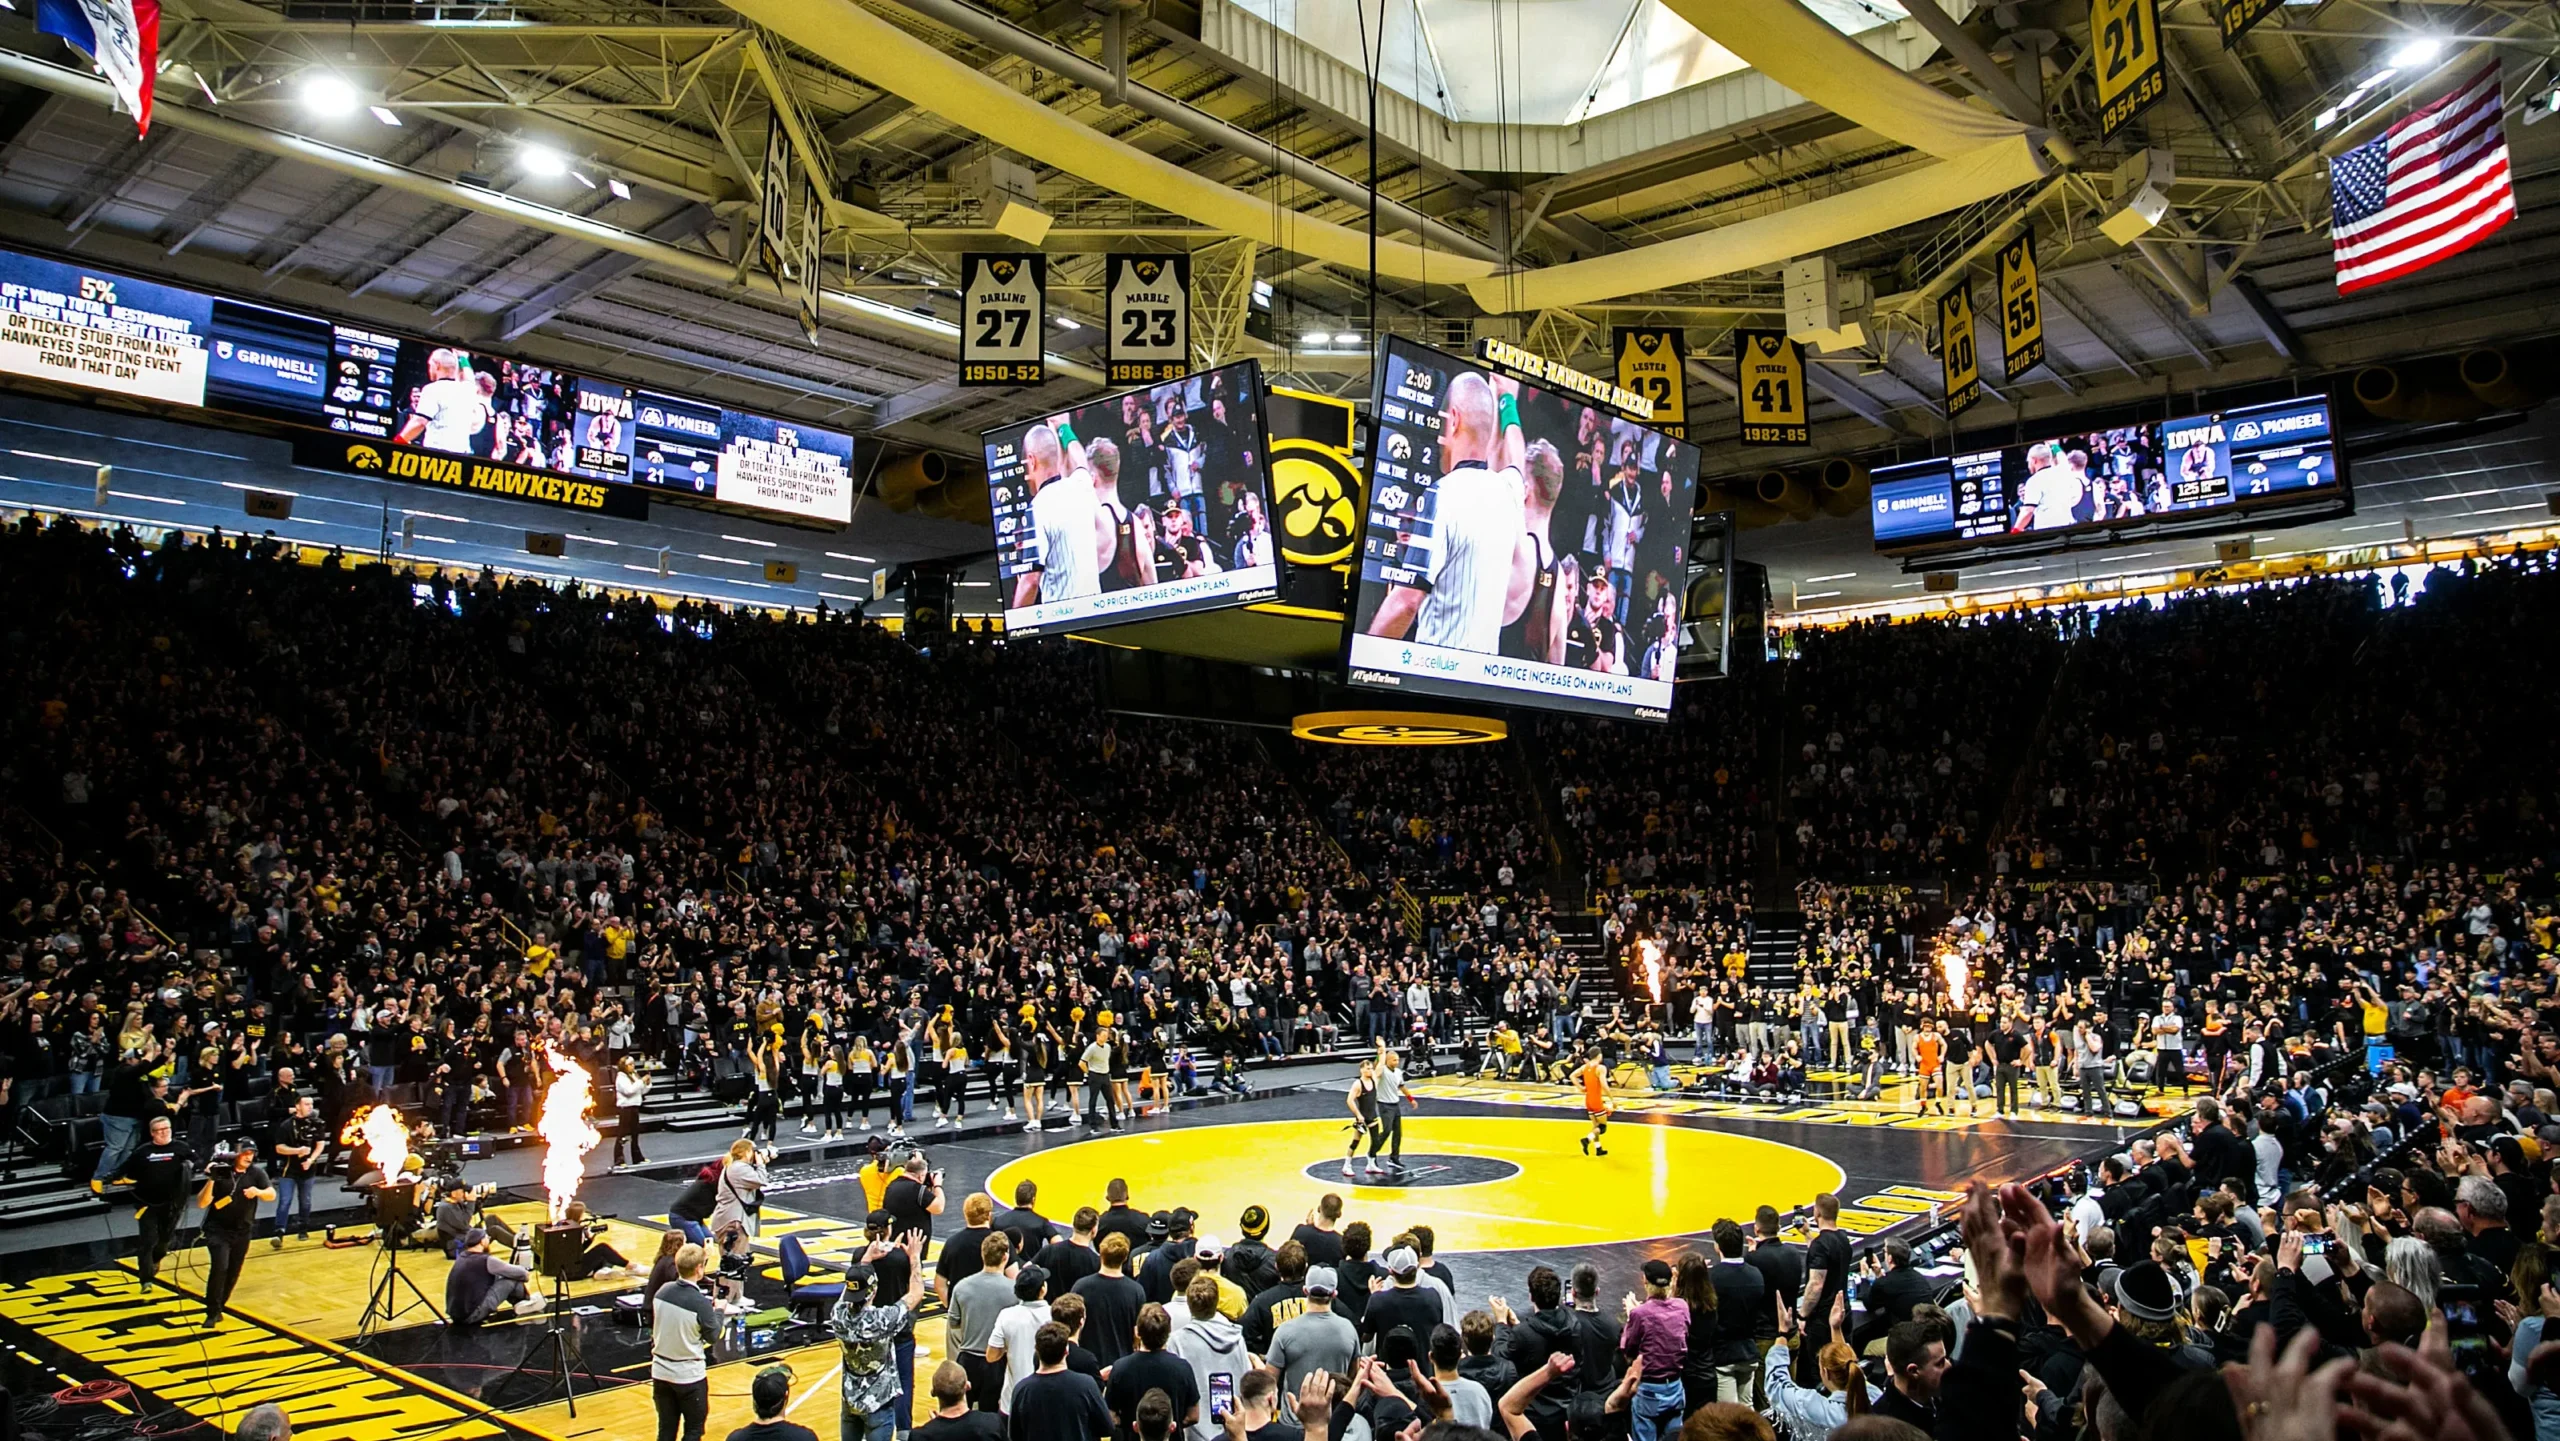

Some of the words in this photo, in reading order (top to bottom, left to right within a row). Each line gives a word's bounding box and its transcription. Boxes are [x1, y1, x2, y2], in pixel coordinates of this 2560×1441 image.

[2104, 2, 2144, 82] 21
[2101, 71, 2163, 135] 1954-56
[1, 282, 28, 300] OFF
[30, 287, 67, 308] YOUR
[81, 275, 117, 304] 5%
[979, 292, 1027, 305] DARLING
[1126, 292, 1170, 305] MARBLE
[2008, 288, 2036, 339] 55
[8, 314, 27, 329] OR
[31, 318, 77, 338] TICKET
[80, 328, 113, 345] STUB
[116, 335, 151, 352] FROM
[155, 343, 178, 358] ANY
[975, 309, 1031, 348] 27
[1121, 309, 1176, 347] 23
[1, 327, 74, 353] HAWKEYES
[77, 343, 142, 366] SPORTING
[145, 355, 182, 374] EVENT
[350, 344, 380, 361] 2:09
[1949, 333, 1973, 379] 40
[2008, 342, 2043, 375] 2018-21
[40, 351, 77, 369] FROM
[81, 358, 112, 375] THAT
[115, 365, 139, 380] DAY
[237, 350, 318, 377] GRINNELL
[965, 366, 1040, 381] 1950-52
[1111, 365, 1186, 380] 1986-89
[1632, 363, 1667, 373] LESTER
[1755, 364, 1788, 374] STOKES
[375, 371, 386, 384] 2
[1405, 368, 1432, 391] 2:09
[1486, 338, 1612, 403] CARVER-HAWKEYE
[1610, 386, 1654, 420] ARENA
[373, 394, 384, 407] 0
[579, 390, 634, 420] IOWA
[1630, 377, 1672, 411] 12
[1751, 379, 1793, 413] 41
[666, 413, 717, 436] PIONEER
[1426, 416, 1441, 430] 125
[2261, 413, 2325, 435] PIONEER
[777, 427, 799, 448] 5%
[1744, 428, 1807, 441] 1982-85
[2166, 425, 2226, 450] IOWA
[581, 447, 602, 465] 125
[1421, 446, 1432, 465] 2
[387, 450, 463, 485] IOWA
[469, 465, 606, 508] HAWKEYES
[646, 467, 665, 484] 21
[695, 476, 705, 491] 0
[740, 459, 751, 470] OR
[751, 461, 777, 475] TICKET
[779, 467, 798, 479] STUB
[799, 470, 820, 482] FROM
[821, 474, 836, 486] ANY
[2307, 471, 2319, 486] 0
[736, 471, 777, 486] HAWKEYES
[778, 479, 815, 494] SPORTING
[816, 486, 838, 498] EVENT
[757, 486, 779, 499] FROM
[780, 490, 798, 502] THAT
[799, 494, 813, 505] DAY
[1017, 485, 1024, 497] 2
[1988, 480, 1997, 491] 2
[2178, 482, 2199, 497] 125
[2250, 478, 2270, 494] 21
[1416, 495, 1425, 513] 0
[1891, 493, 1947, 511] GRINNELL
[1021, 515, 1027, 527] 0
[1382, 542, 1398, 557] LEE
[2325, 546, 2389, 568] IOWA
[1093, 600, 1105, 611] NO
[1107, 596, 1129, 608] PRICE
[1130, 588, 1169, 604] INCREASE
[1170, 586, 1183, 598] ON
[1185, 583, 1202, 596] ANY
[1203, 578, 1231, 594] PLANS
[1483, 664, 1499, 677] NO
[1501, 667, 1527, 682] PRICE
[1529, 671, 1571, 688] INCREASE
[1574, 676, 1587, 689] ON
[1589, 680, 1605, 692] ANY
[1607, 683, 1633, 696] PLANS
